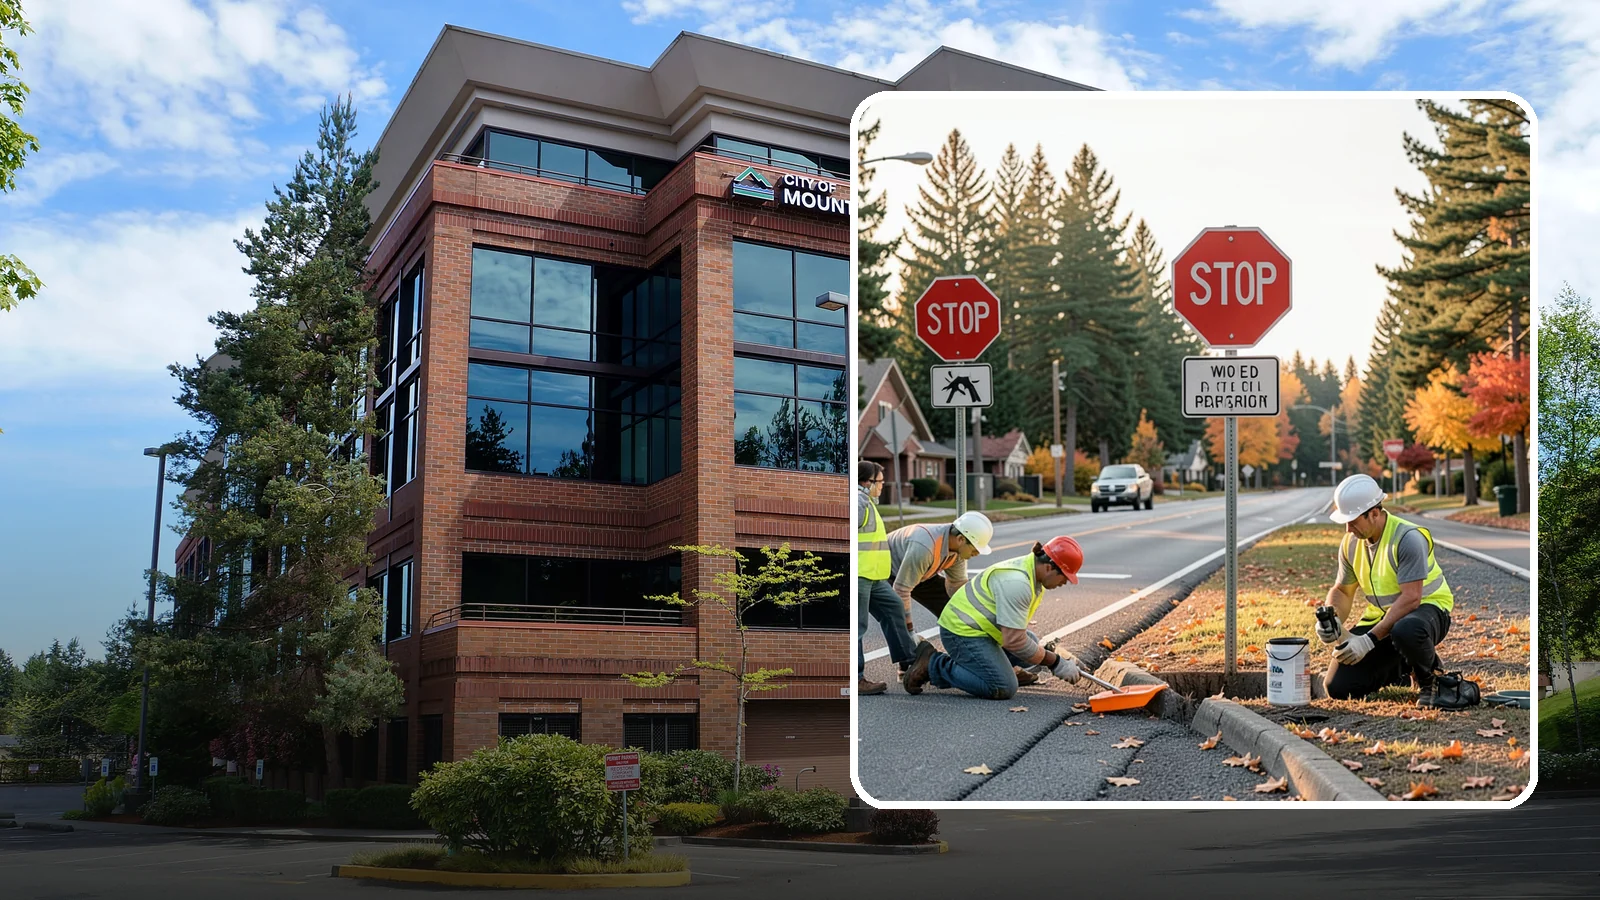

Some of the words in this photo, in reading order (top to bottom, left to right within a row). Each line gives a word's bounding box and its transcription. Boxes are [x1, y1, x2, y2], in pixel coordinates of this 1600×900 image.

[784, 174, 817, 190] CITY
[818, 181, 836, 193] OF
[1190, 261, 1277, 306] STOP
[927, 301, 990, 335] STOP
